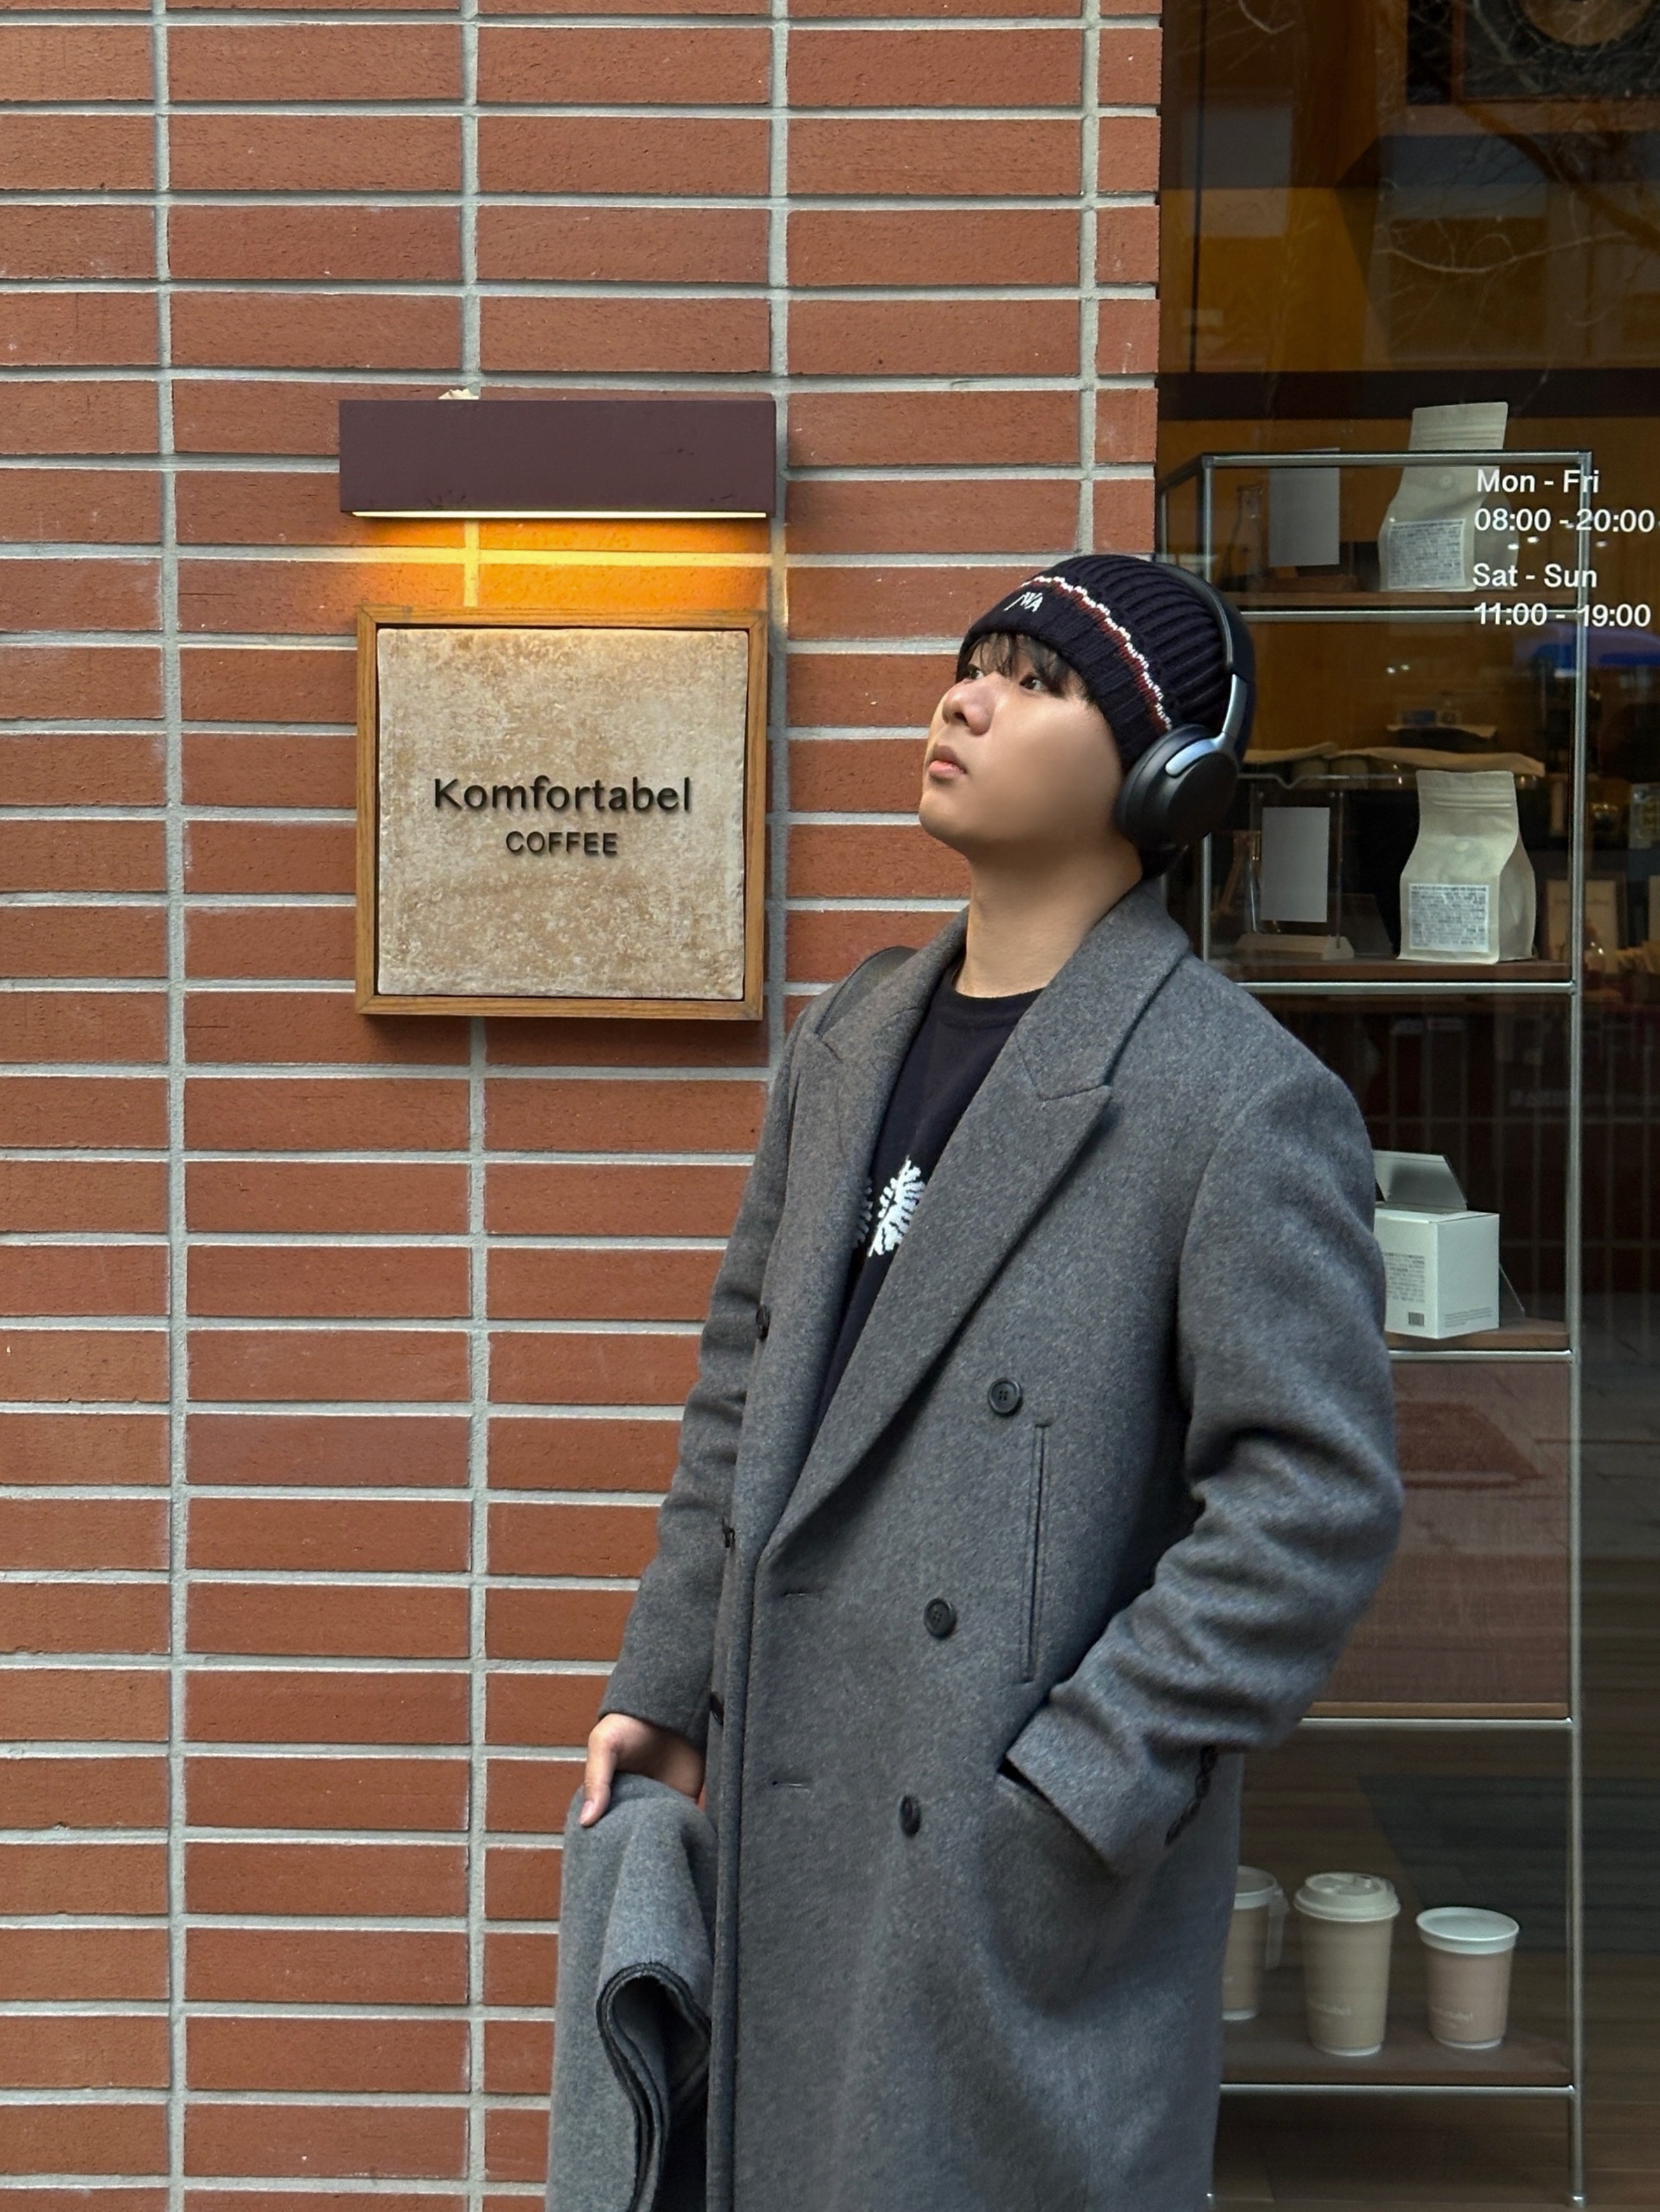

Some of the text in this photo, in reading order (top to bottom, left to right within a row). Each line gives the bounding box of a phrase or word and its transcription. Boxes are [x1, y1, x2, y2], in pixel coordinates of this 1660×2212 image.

[1477, 469, 1535, 493] Mon
[1563, 469, 1599, 494] Fri
[1474, 507, 1552, 532] 08:00
[1576, 509, 1655, 533] 20:00
[1473, 562, 1518, 587] Sat
[1544, 564, 1598, 588] Sun
[1474, 602, 1548, 626] 11:00
[1578, 603, 1651, 627] 19:00
[434, 775, 690, 813] Komfortabel
[506, 830, 618, 856] COFFEE
